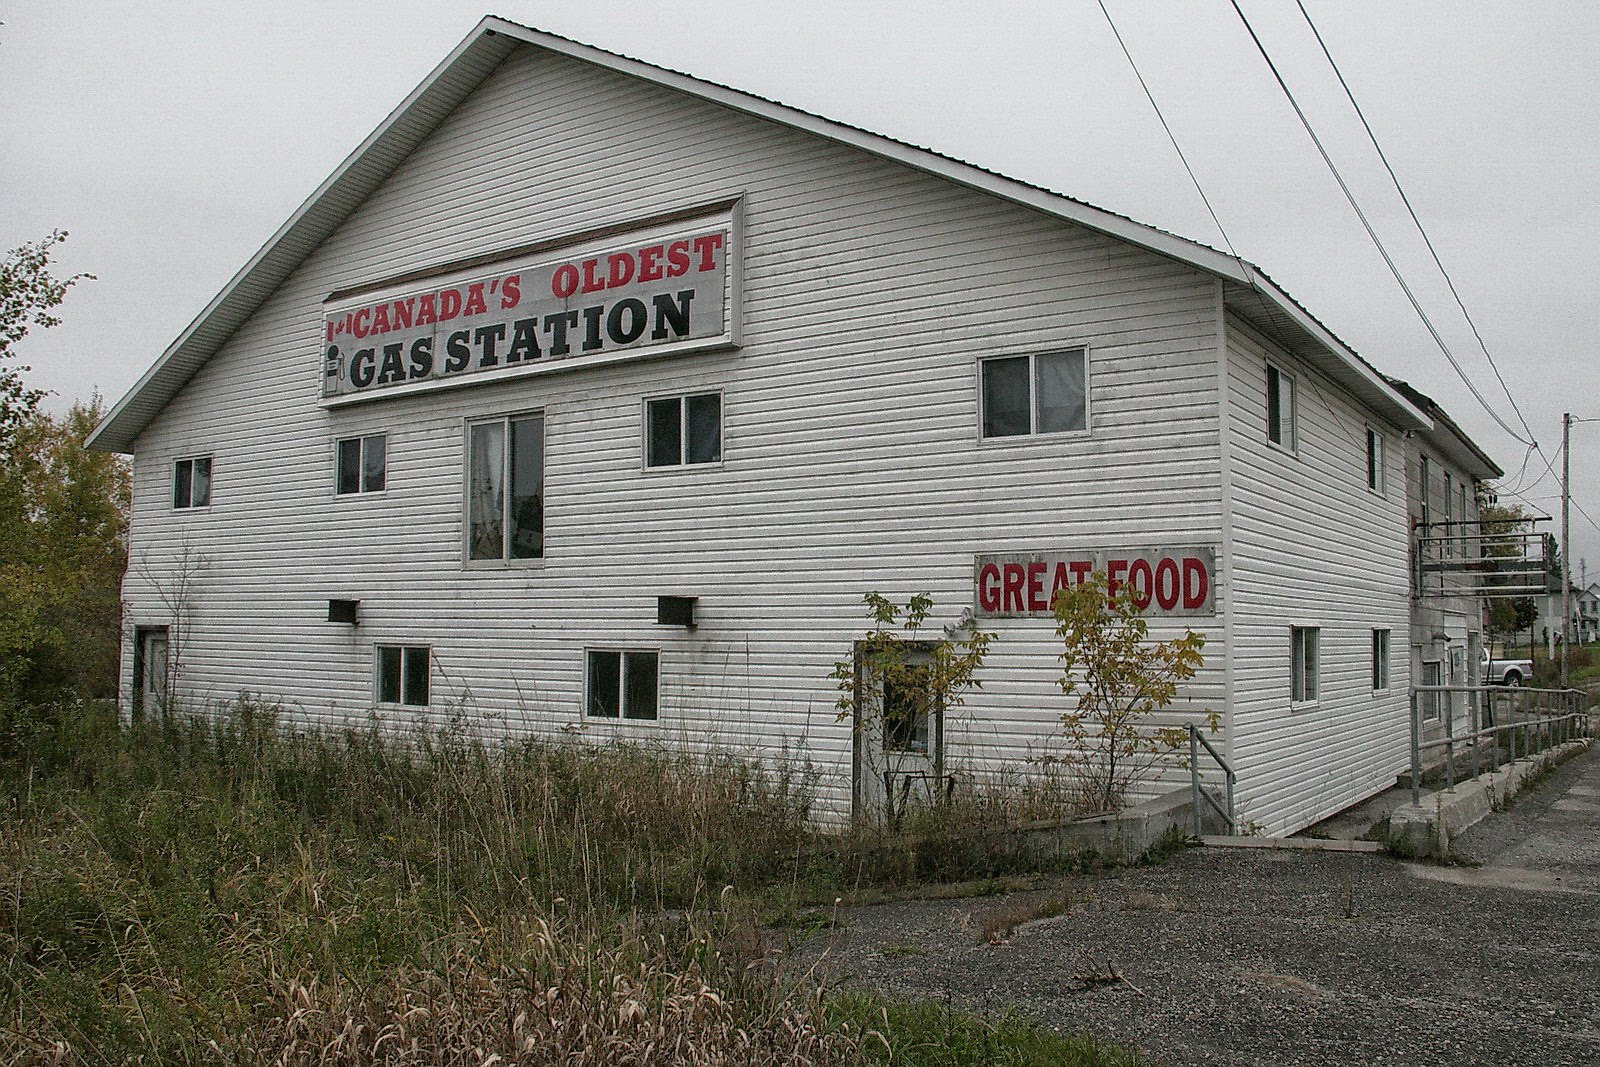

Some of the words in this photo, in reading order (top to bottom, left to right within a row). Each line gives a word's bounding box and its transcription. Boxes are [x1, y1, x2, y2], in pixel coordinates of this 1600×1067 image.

[352, 275, 522, 340] CANADA'S
[551, 233, 723, 299] OLDEST
[349, 336, 434, 388] GAS
[444, 288, 696, 374] STATION
[1107, 557, 1209, 611] FOOD
